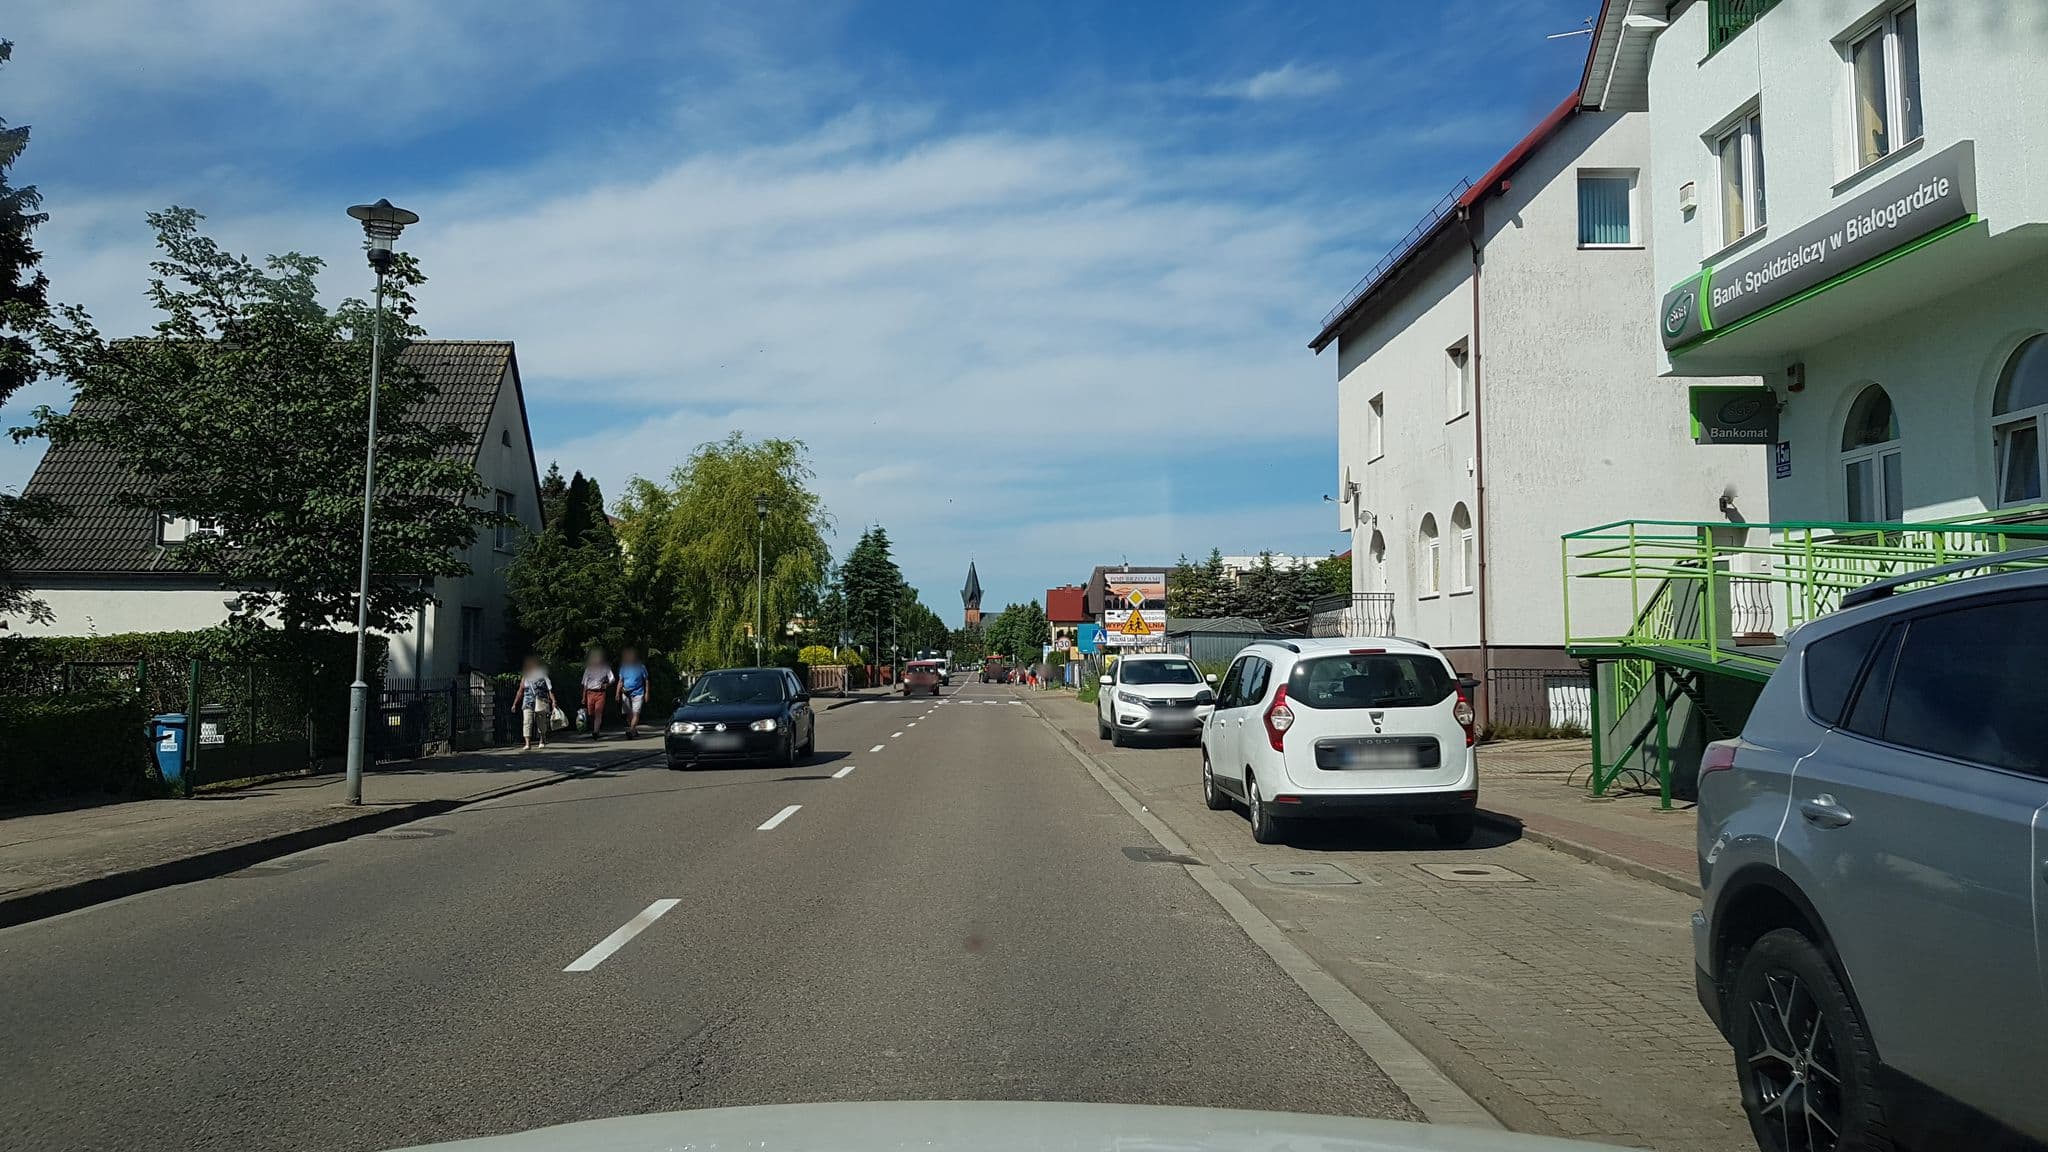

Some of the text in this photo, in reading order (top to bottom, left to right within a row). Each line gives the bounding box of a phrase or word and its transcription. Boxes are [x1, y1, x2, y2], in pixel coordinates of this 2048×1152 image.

[1713, 176, 1949, 308] Bank Spółdzielczy w Białogardzie
[1710, 427, 1768, 438] Bankomat
[1060, 640, 1070, 648] 30
